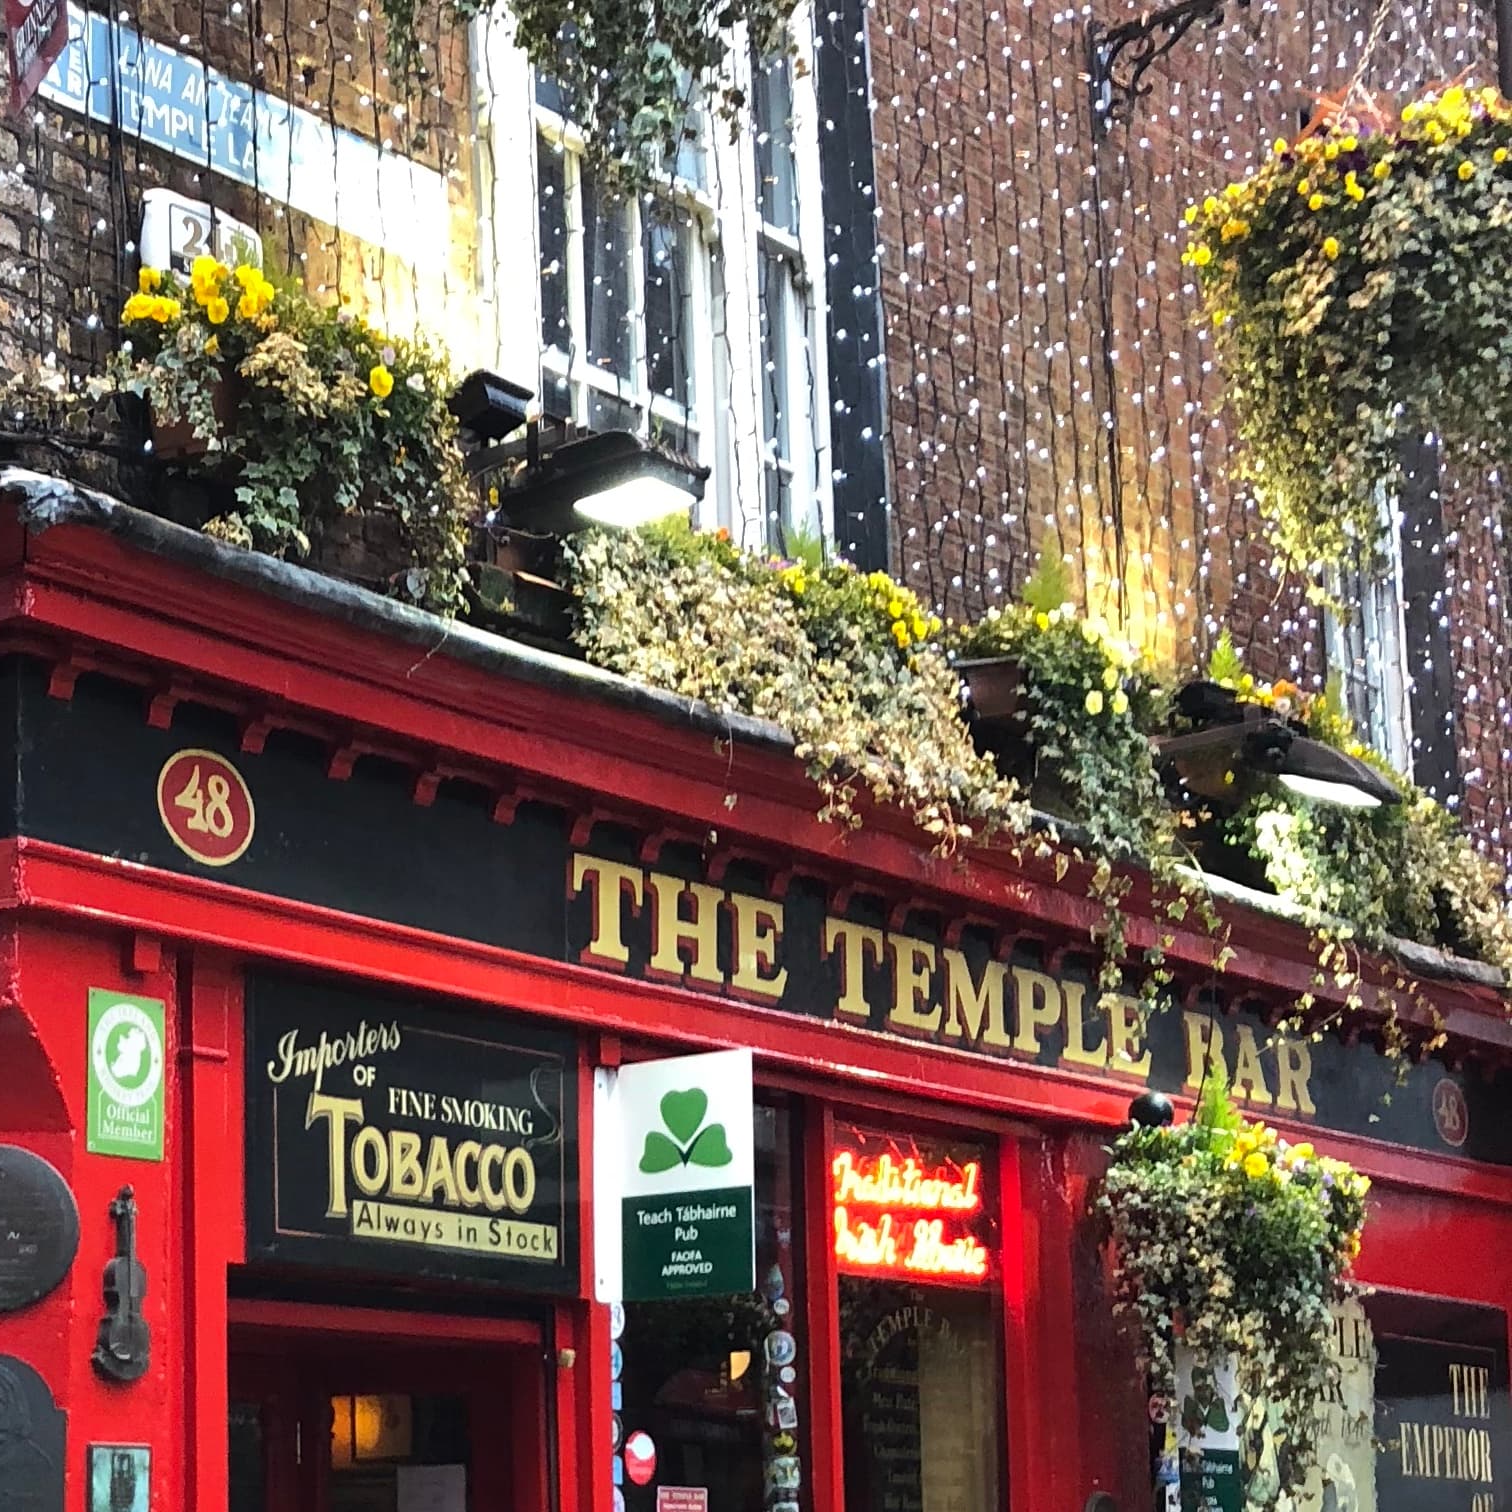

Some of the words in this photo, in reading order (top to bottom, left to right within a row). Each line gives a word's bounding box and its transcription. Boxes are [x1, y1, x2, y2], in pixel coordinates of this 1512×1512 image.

[181, 72, 210, 106] AN
[116, 84, 216, 156] TEMPLE
[174, 764, 234, 838] 48
[572, 851, 788, 999] THE
[824, 913, 1153, 1079] TEMPLE
[1183, 1008, 1317, 1116] BAR
[267, 1018, 401, 1092] Importers
[352, 1065, 377, 1088] OF
[102, 1120, 153, 1142] Member
[106, 1103, 150, 1124] Official
[387, 1086, 437, 1122] FINE
[440, 1097, 534, 1137] SMOKING
[305, 1091, 536, 1219] TOBACCO
[833, 1152, 978, 1209] Traditional
[355, 1200, 444, 1241] Always
[457, 1216, 478, 1243] in
[488, 1222, 554, 1254] Stock
[637, 1208, 673, 1227] Teach
[675, 1202, 737, 1223] Tábhairne
[674, 1225, 699, 1242] Pub
[661, 1262, 713, 1277] APPROVED
[1449, 1363, 1490, 1420] THE
[1399, 1421, 1494, 1483] EMPEROR
